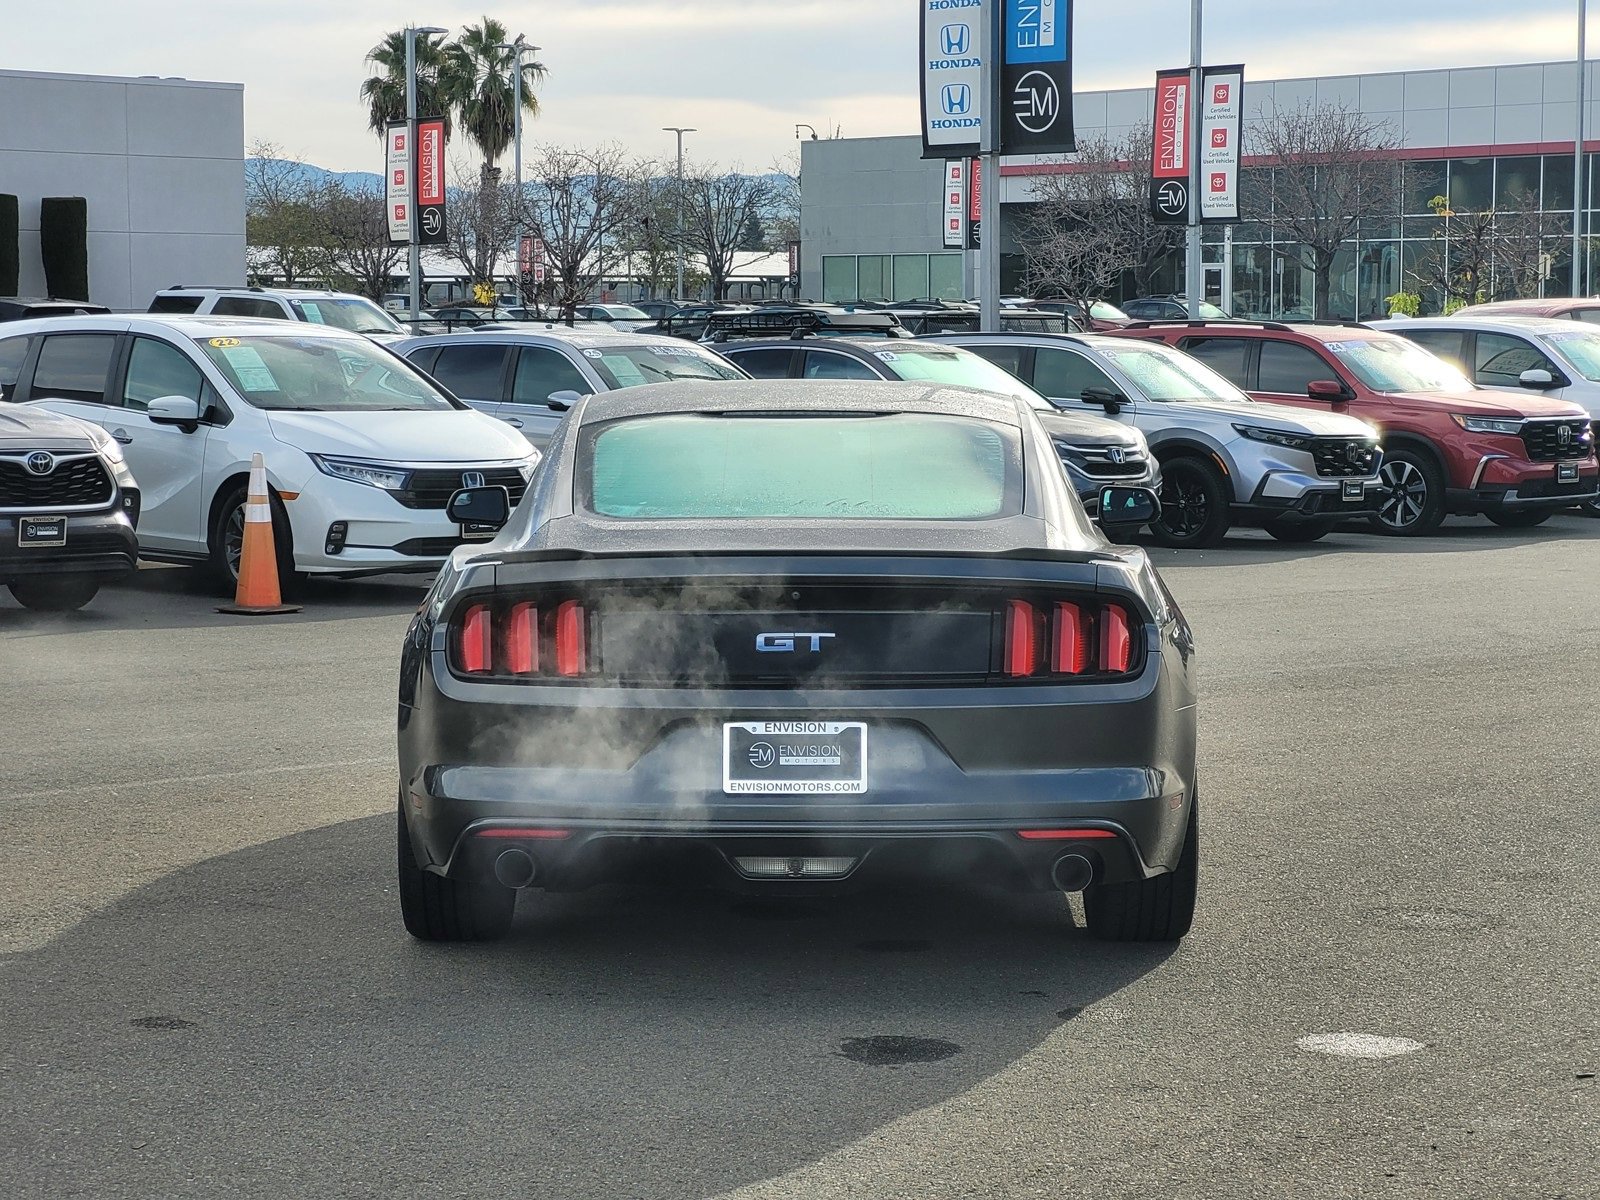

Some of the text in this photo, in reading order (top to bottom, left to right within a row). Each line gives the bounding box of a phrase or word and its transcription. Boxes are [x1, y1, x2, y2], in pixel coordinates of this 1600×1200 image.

[929, 0, 981, 10] HONDA
[929, 58, 981, 70] HONDA
[931, 118, 981, 129] HONDA
[1161, 85, 1177, 169] ENVISION
[1176, 92, 1184, 162] MOTORS
[422, 130, 432, 198] ENVISION
[755, 632, 836, 652] GT
[764, 722, 827, 733] ENVISION
[779, 745, 841, 757] ENVISION
[730, 782, 861, 792] ENVISIONMOTORS.COM
